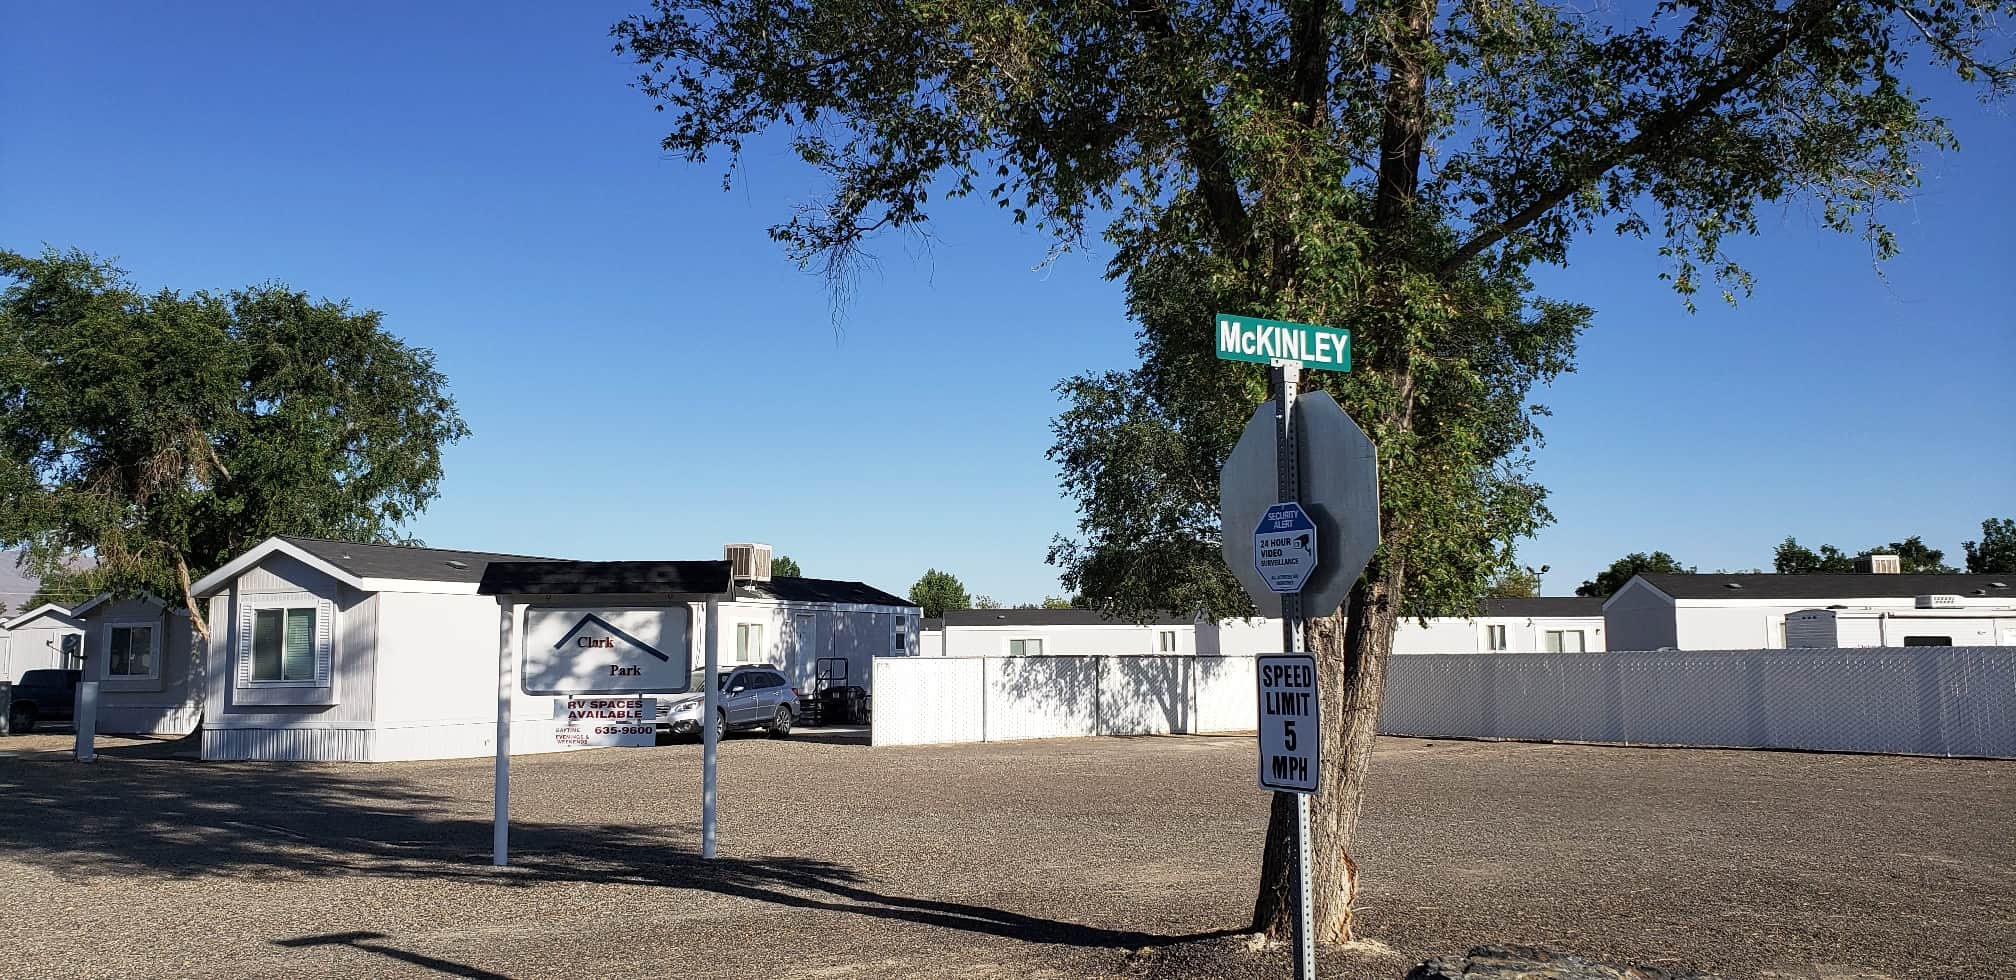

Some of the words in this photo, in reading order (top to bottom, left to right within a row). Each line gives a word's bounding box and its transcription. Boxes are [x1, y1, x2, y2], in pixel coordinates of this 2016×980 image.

[1220, 320, 1348, 364] McKINLEY
[1267, 510, 1299, 521] SECURITY
[1273, 520, 1293, 529] ALERT
[1260, 540, 1269, 548] 24
[1270, 537, 1292, 547] HOUR
[1261, 549, 1283, 558] VIDEO
[1260, 558, 1299, 567] SURVEILLANCE
[577, 636, 615, 649] Clark
[609, 664, 641, 677] Park
[1263, 664, 1312, 688] SPEED
[567, 700, 587, 710] RV
[591, 700, 643, 709] SPACES
[1266, 692, 1310, 716] LIMIT
[568, 710, 643, 719] AVAILABLE
[594, 726, 653, 735] 635-9600
[1284, 720, 1297, 751] 5
[1272, 755, 1308, 781] MPH
